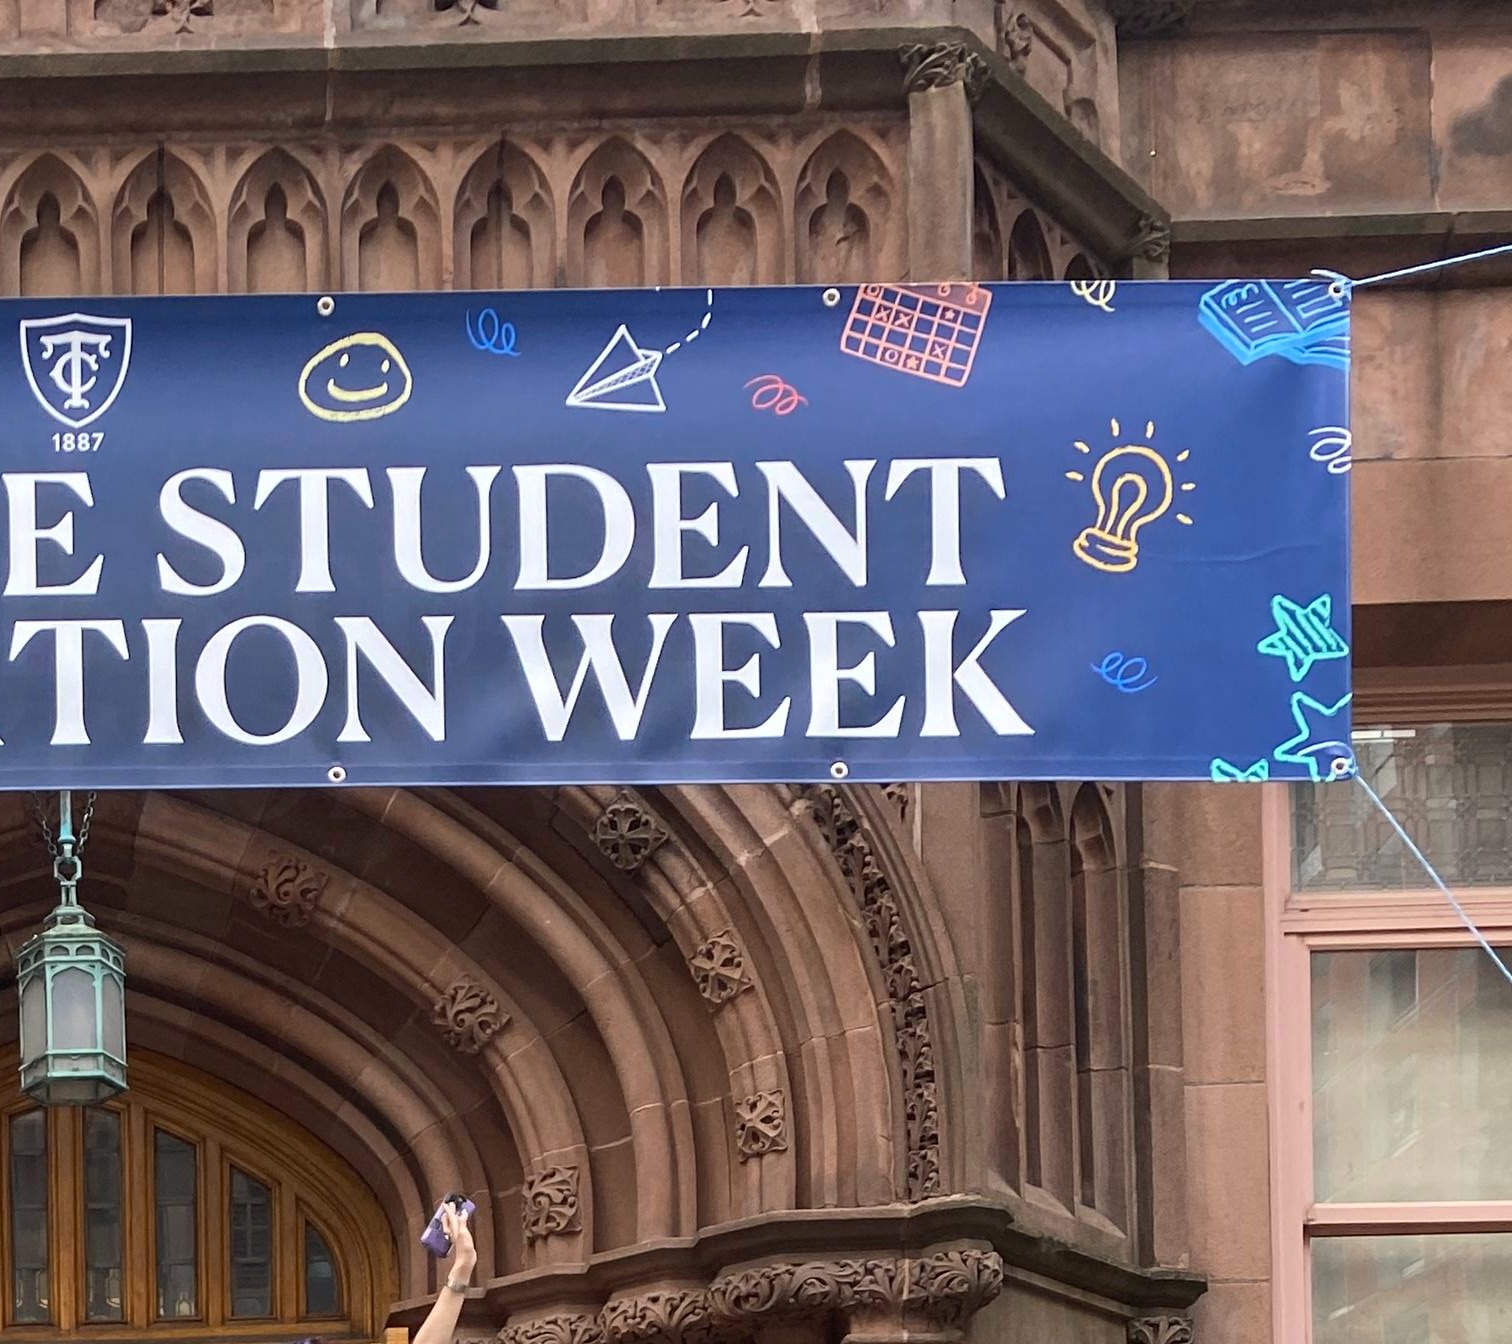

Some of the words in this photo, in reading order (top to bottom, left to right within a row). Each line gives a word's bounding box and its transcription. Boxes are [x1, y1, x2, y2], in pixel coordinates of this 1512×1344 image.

[51, 431, 105, 453] 1887
[156, 457, 1006, 597] STUDENT
[500, 609, 1036, 742] WEEK
